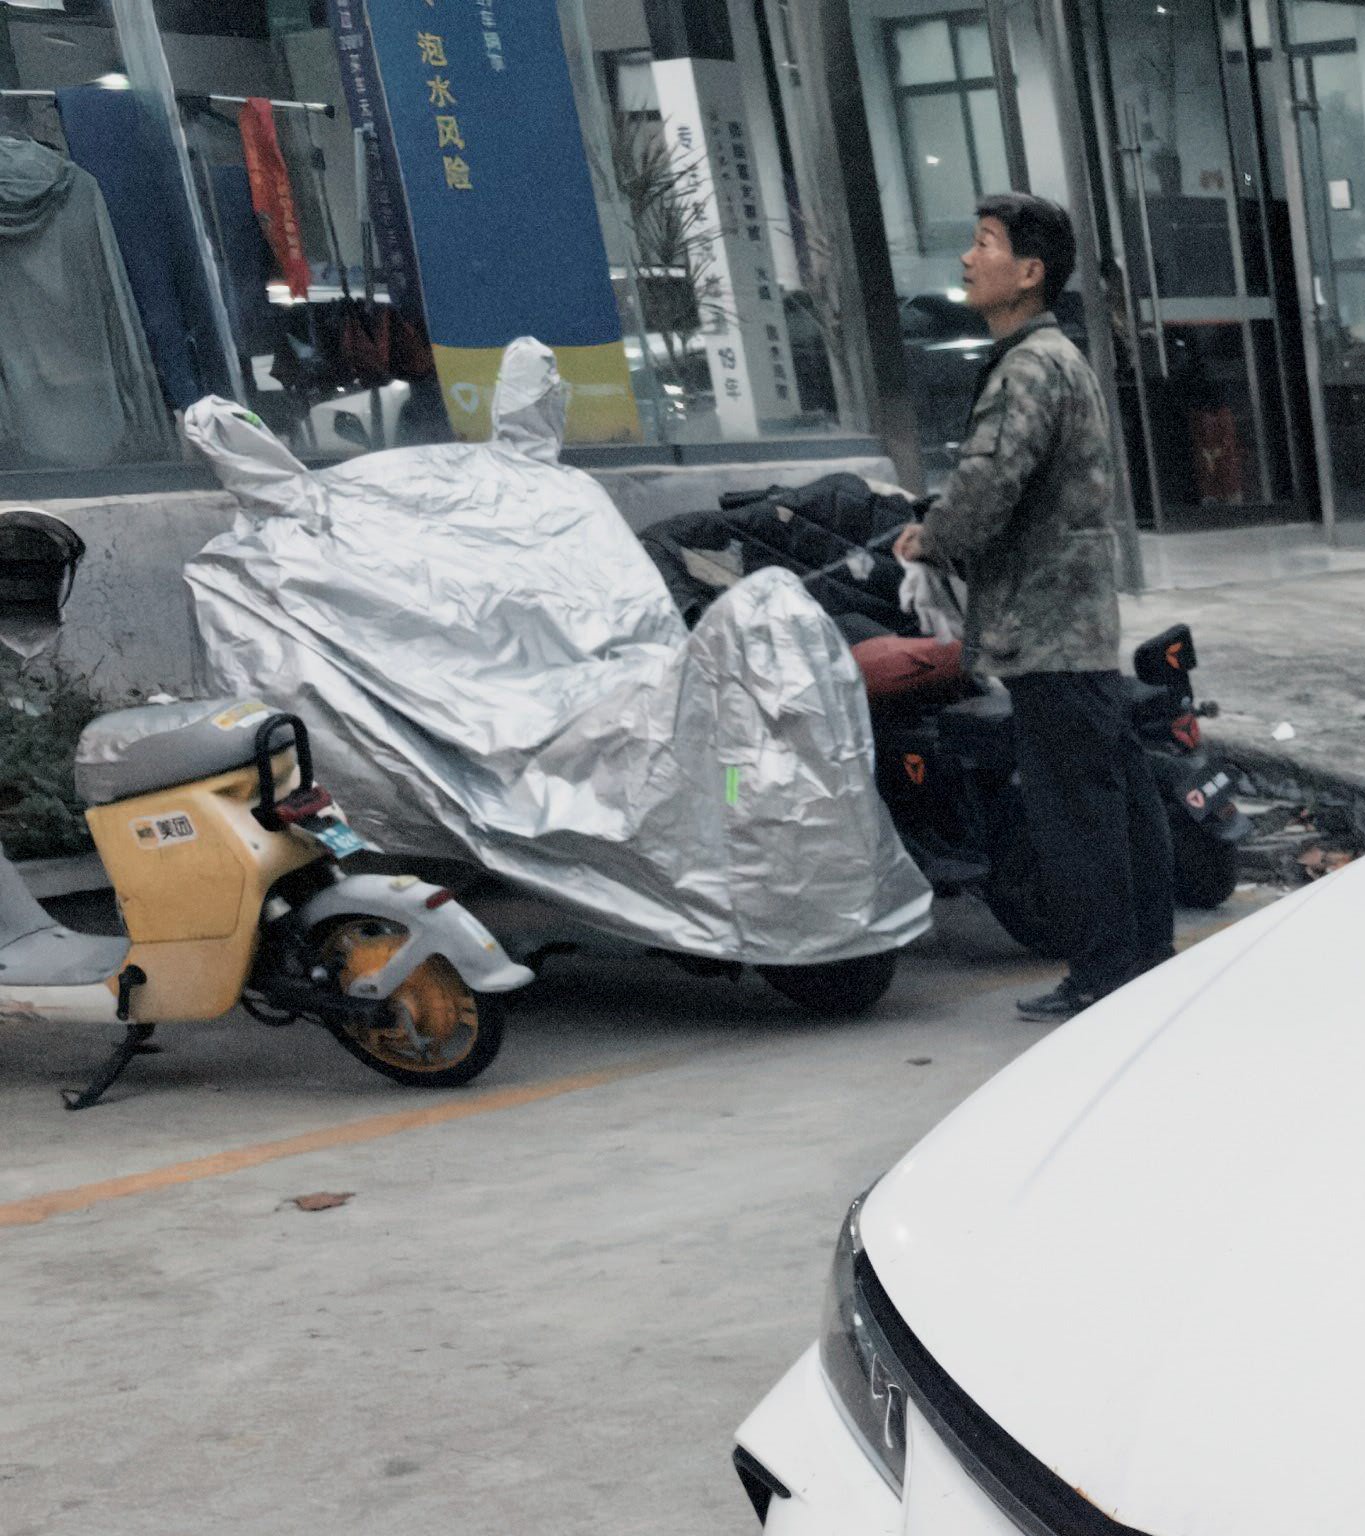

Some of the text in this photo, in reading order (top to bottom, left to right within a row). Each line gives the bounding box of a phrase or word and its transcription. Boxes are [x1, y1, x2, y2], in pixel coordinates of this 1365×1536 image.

[417, 31, 473, 190] 泡水风险
[156, 816, 194, 840] 美团
